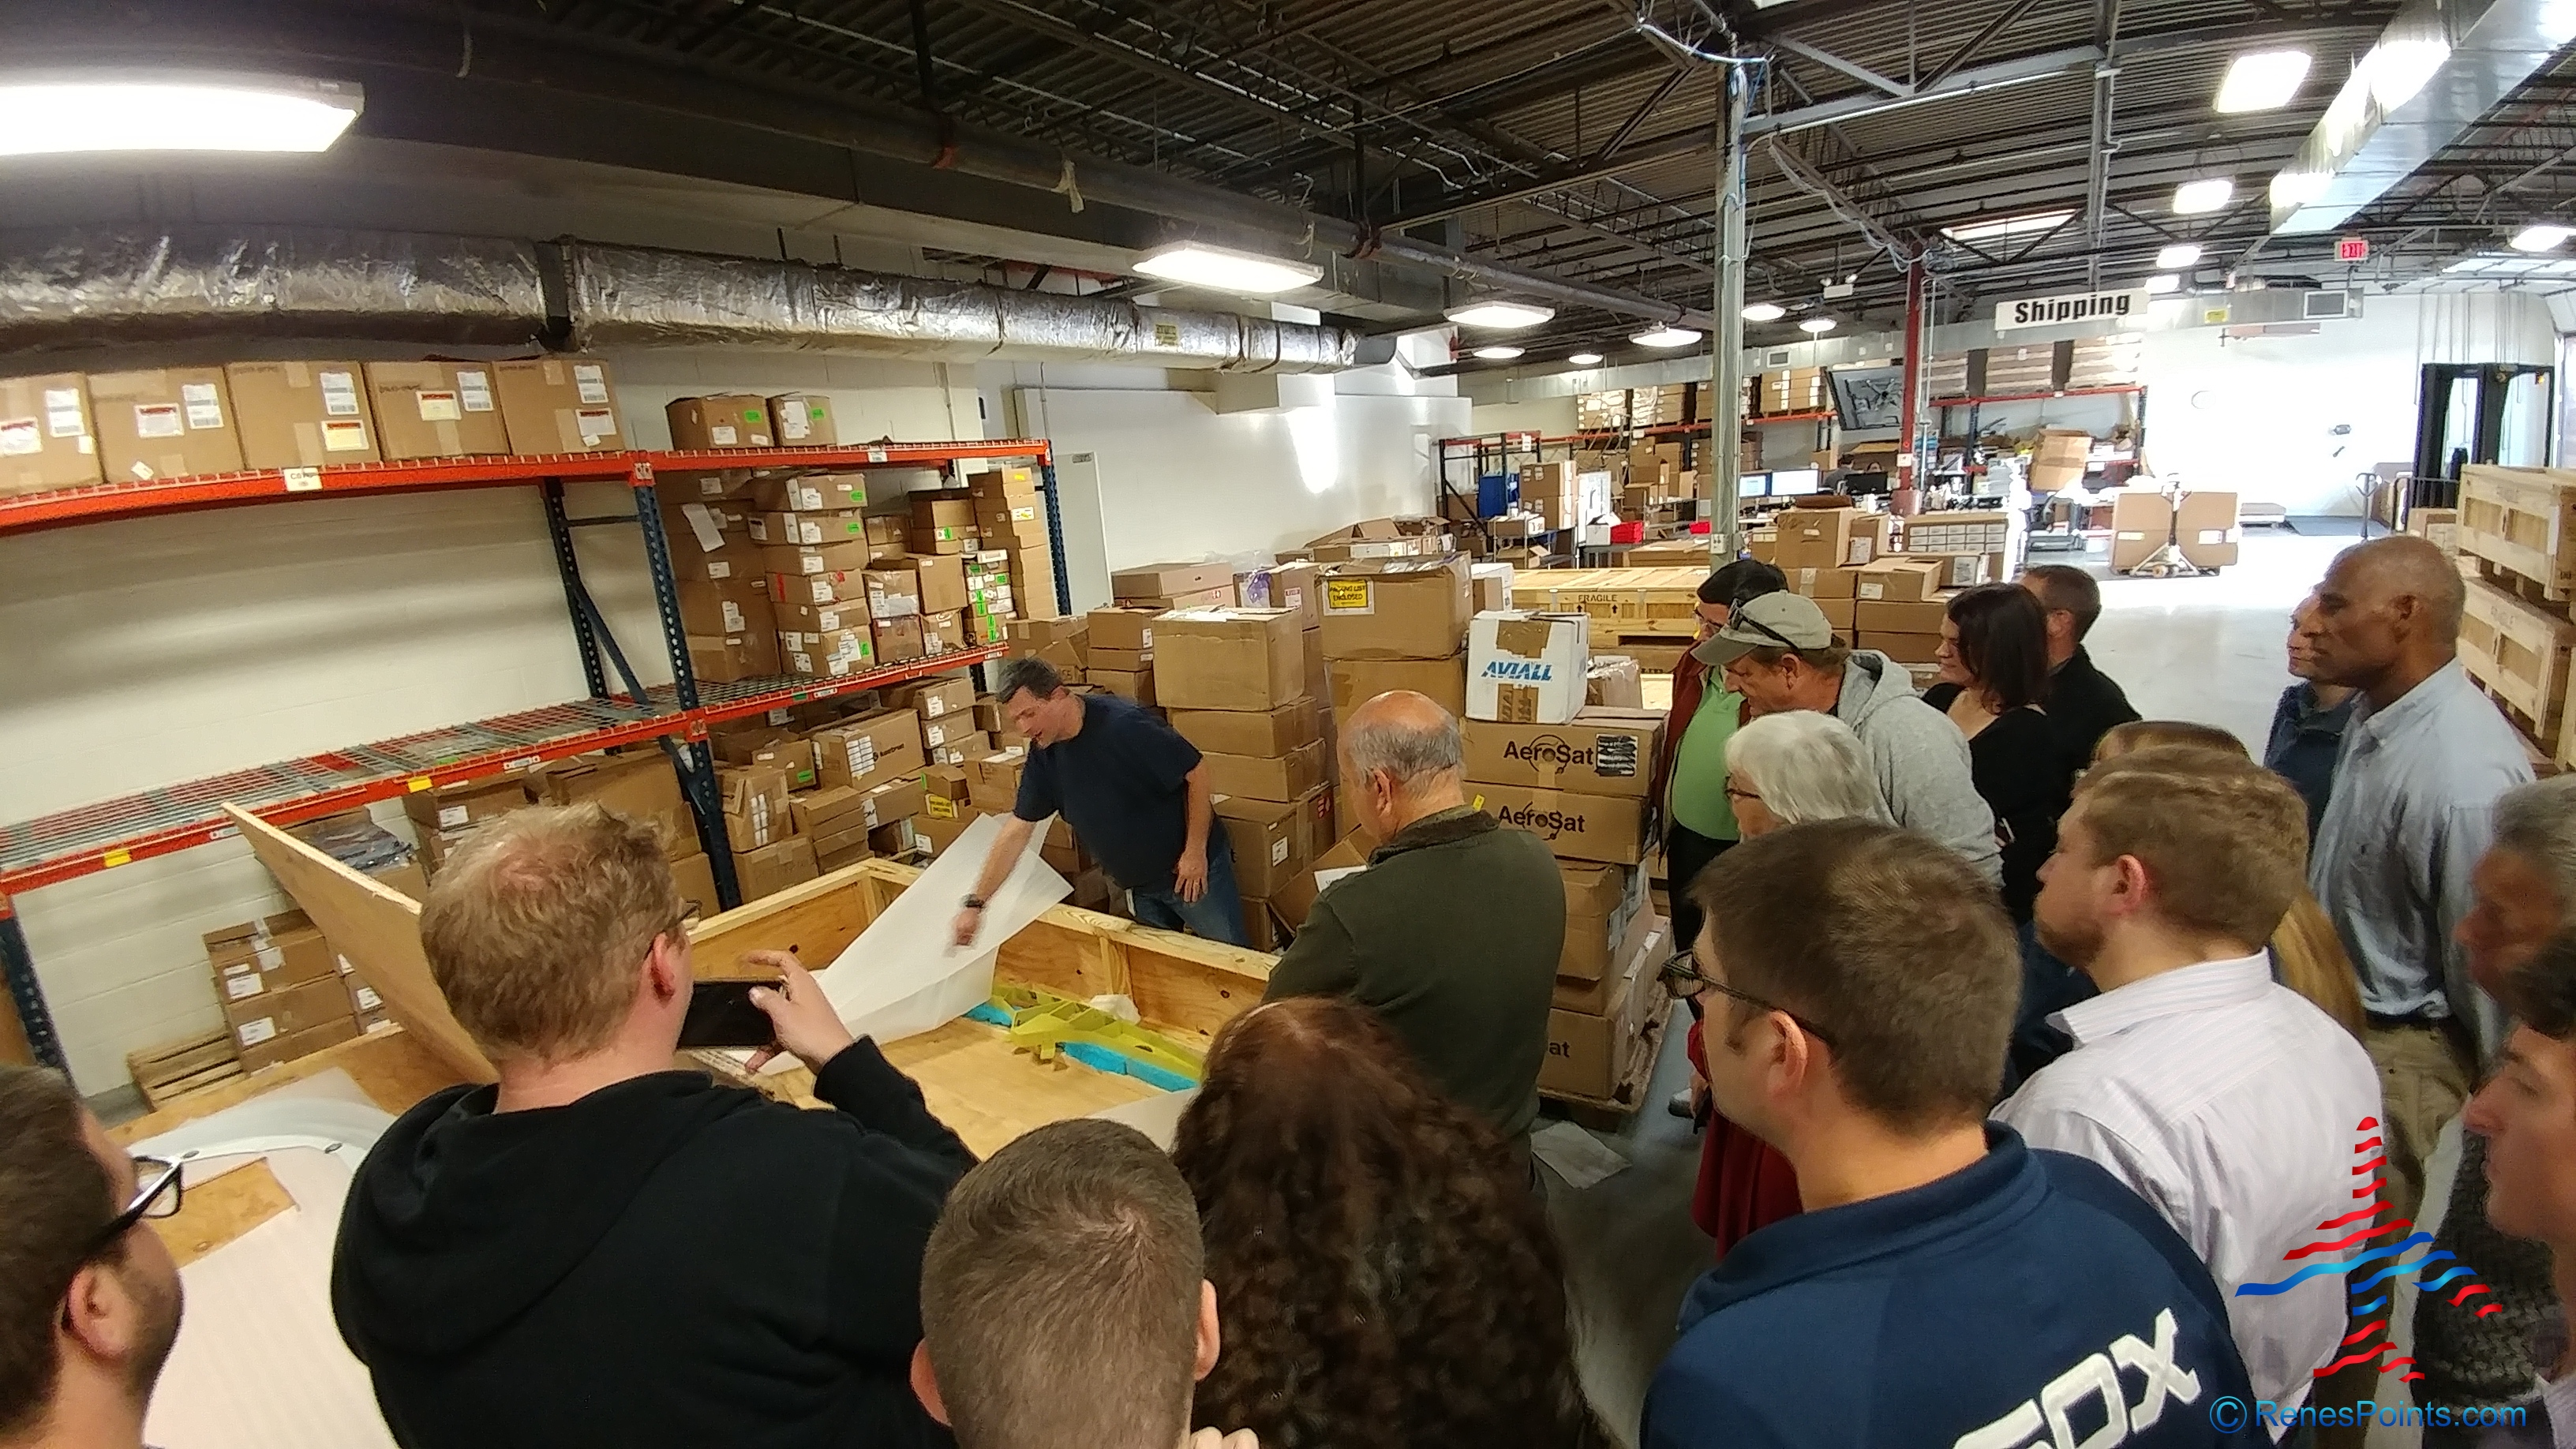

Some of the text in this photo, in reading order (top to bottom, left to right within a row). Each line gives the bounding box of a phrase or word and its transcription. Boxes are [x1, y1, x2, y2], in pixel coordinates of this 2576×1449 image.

[2014, 294, 2131, 324] Shipping
[1481, 661, 1552, 681] AVIALL
[1503, 740, 1594, 766] AeroSat
[1499, 805, 1585, 833] AeroSat
